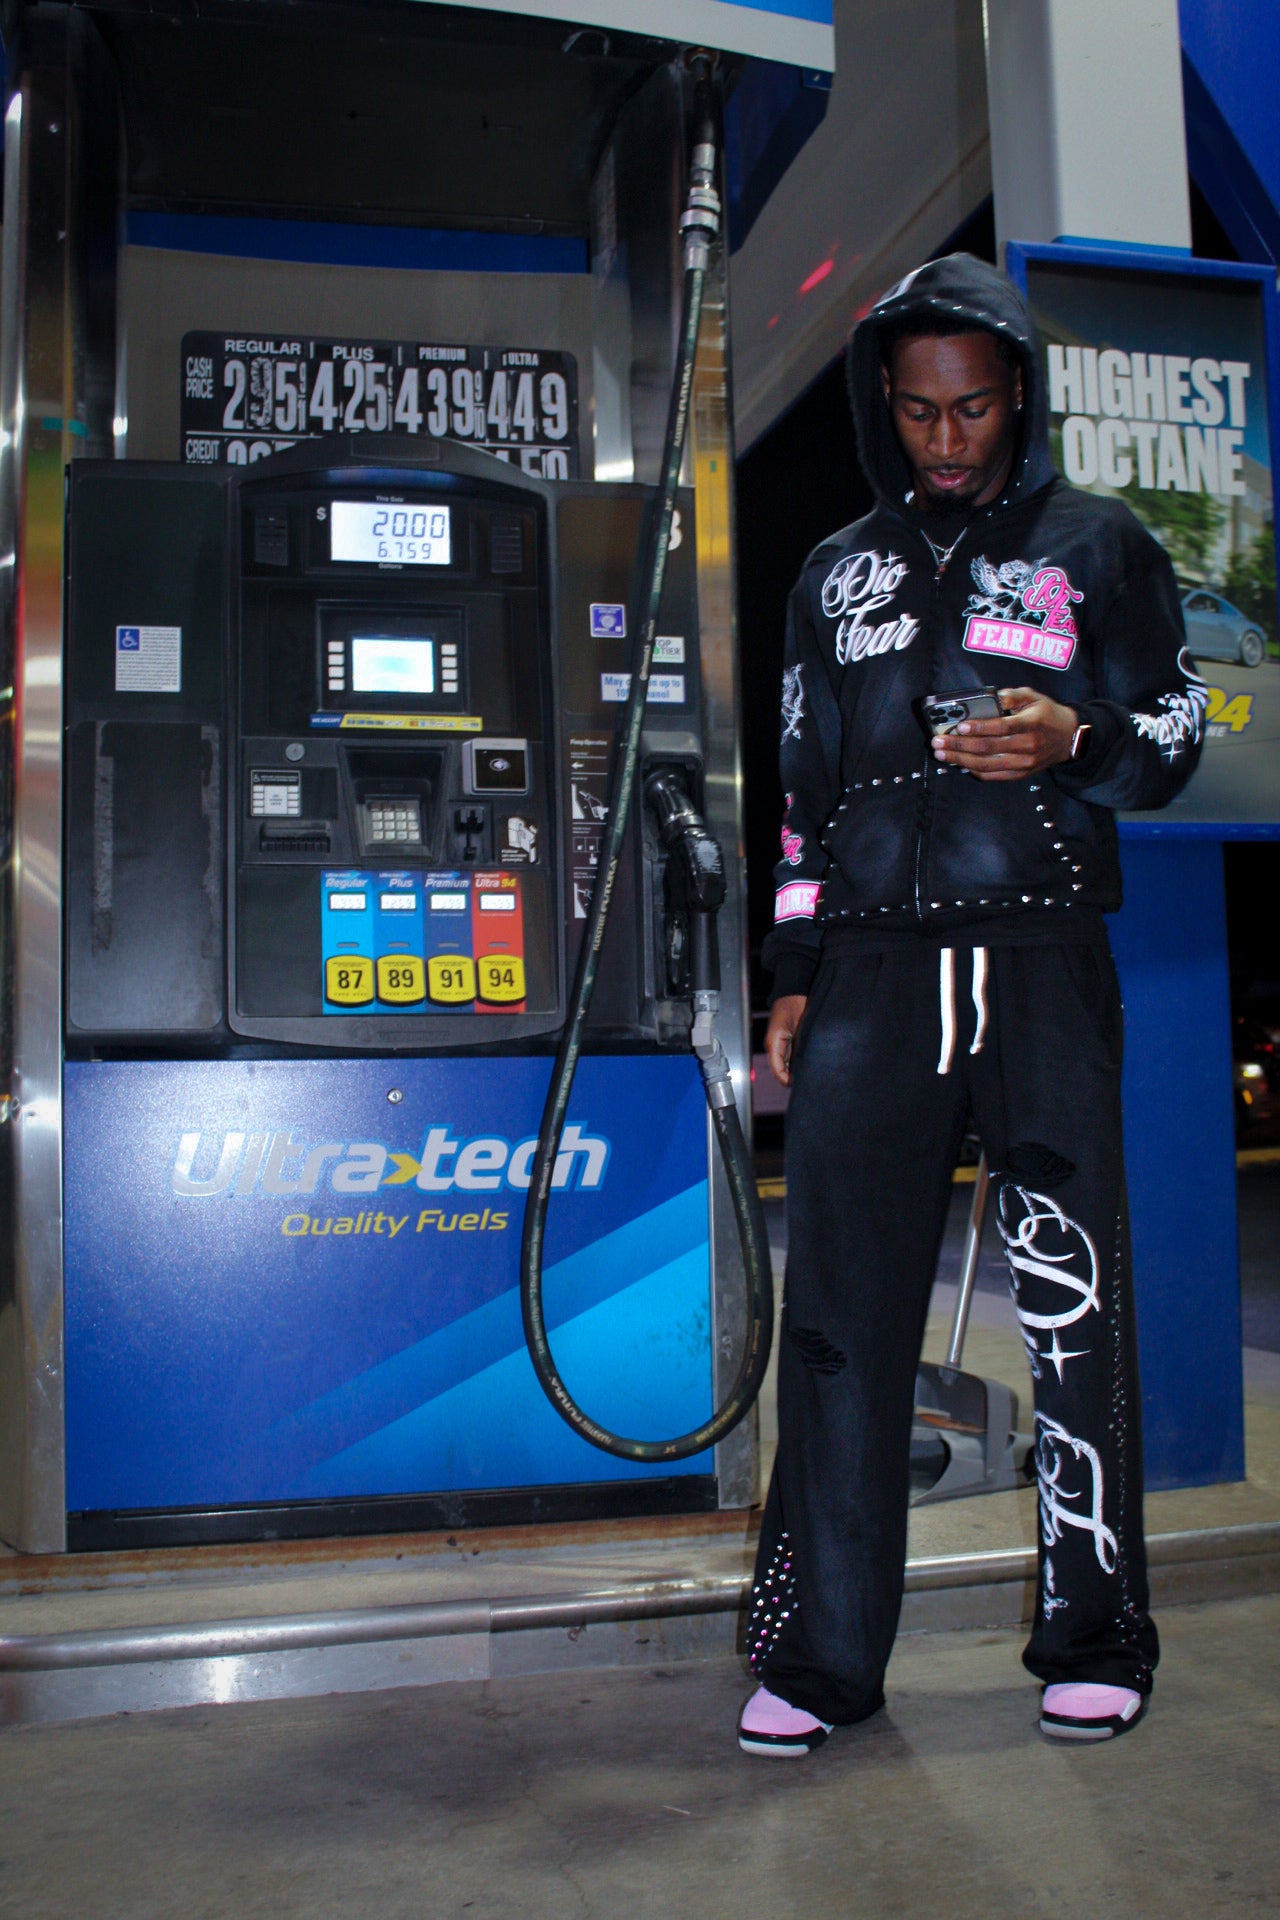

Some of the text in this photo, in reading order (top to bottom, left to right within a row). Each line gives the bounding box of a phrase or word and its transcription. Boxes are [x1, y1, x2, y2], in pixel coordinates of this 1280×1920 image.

[224, 339, 301, 355] REGULAR
[332, 345, 375, 361] PLUS
[418, 346, 467, 361] PREMIUM
[185, 356, 213, 378] CASH
[507, 352, 540, 367] ULTRA
[185, 378, 214, 399] PRICE
[1047, 344, 1250, 428] HIGHEST
[185, 438, 220, 460] CREDIT
[1061, 415, 1247, 497] OCTANE
[316, 506, 327, 521] $
[378, 541, 432, 560] 6.759
[970, 622, 1070, 664] FEAR ONE
[604, 676, 623, 687] May
[325, 878, 367, 890] Regular
[388, 878, 414, 888] Plus
[425, 878, 470, 888] Premium
[475, 878, 517, 888] Ultra 94
[338, 969, 363, 989] 87
[387, 968, 414, 988] 89
[441, 969, 463, 988] 91
[489, 968, 515, 987] 94
[281, 1208, 509, 1238] Quality Fuels
